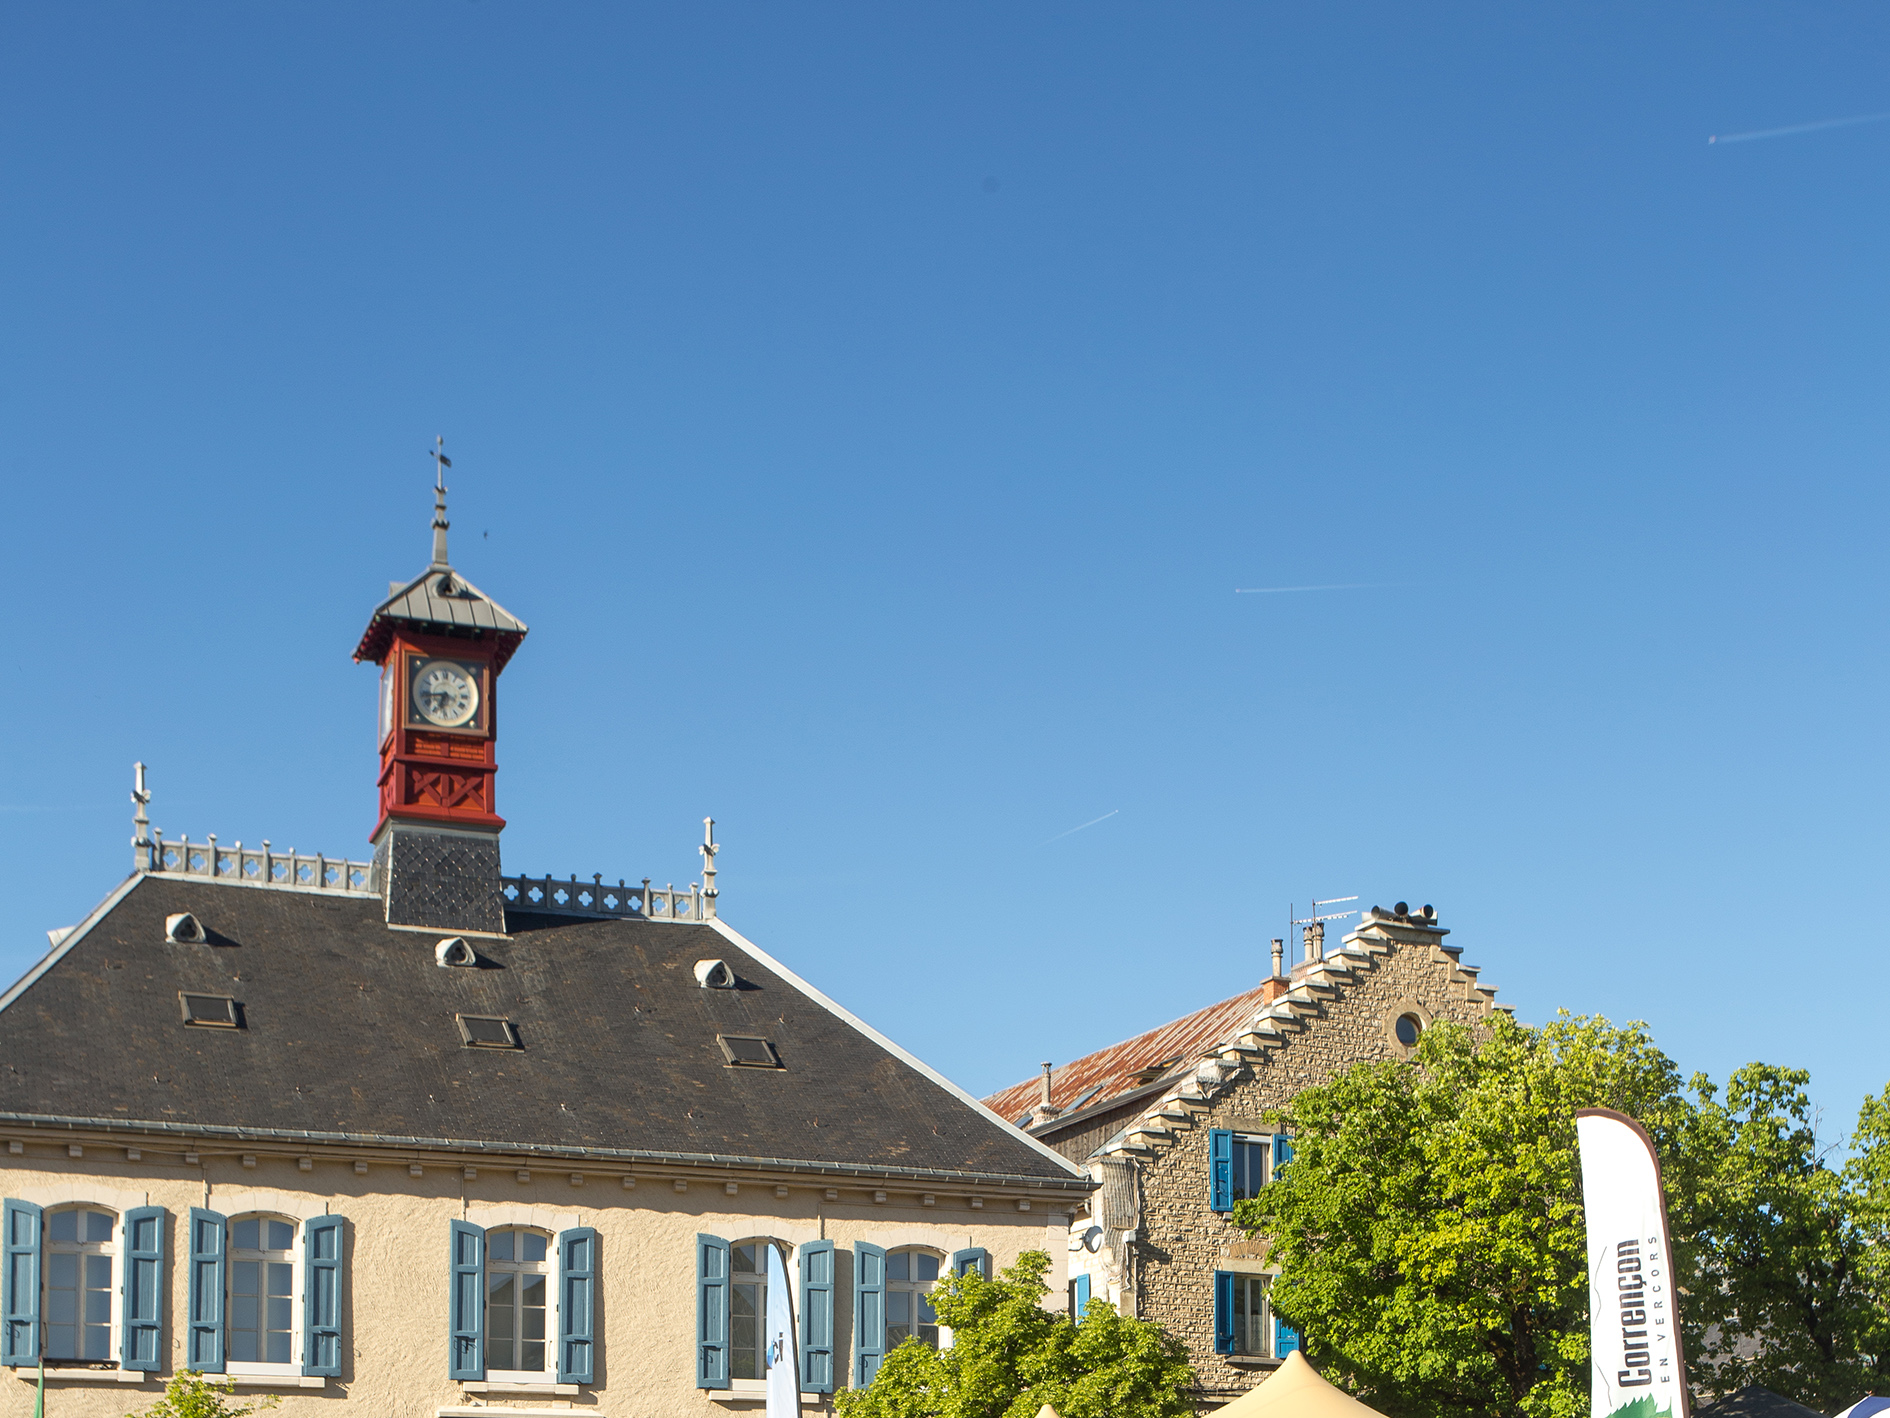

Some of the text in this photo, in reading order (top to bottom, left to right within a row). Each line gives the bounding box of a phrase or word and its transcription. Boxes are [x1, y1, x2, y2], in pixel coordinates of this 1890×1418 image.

[1616, 1238, 1652, 1388] Corrençon
[1648, 1236, 1666, 1342] VERCORS
[1659, 1357, 1670, 1383] EN
